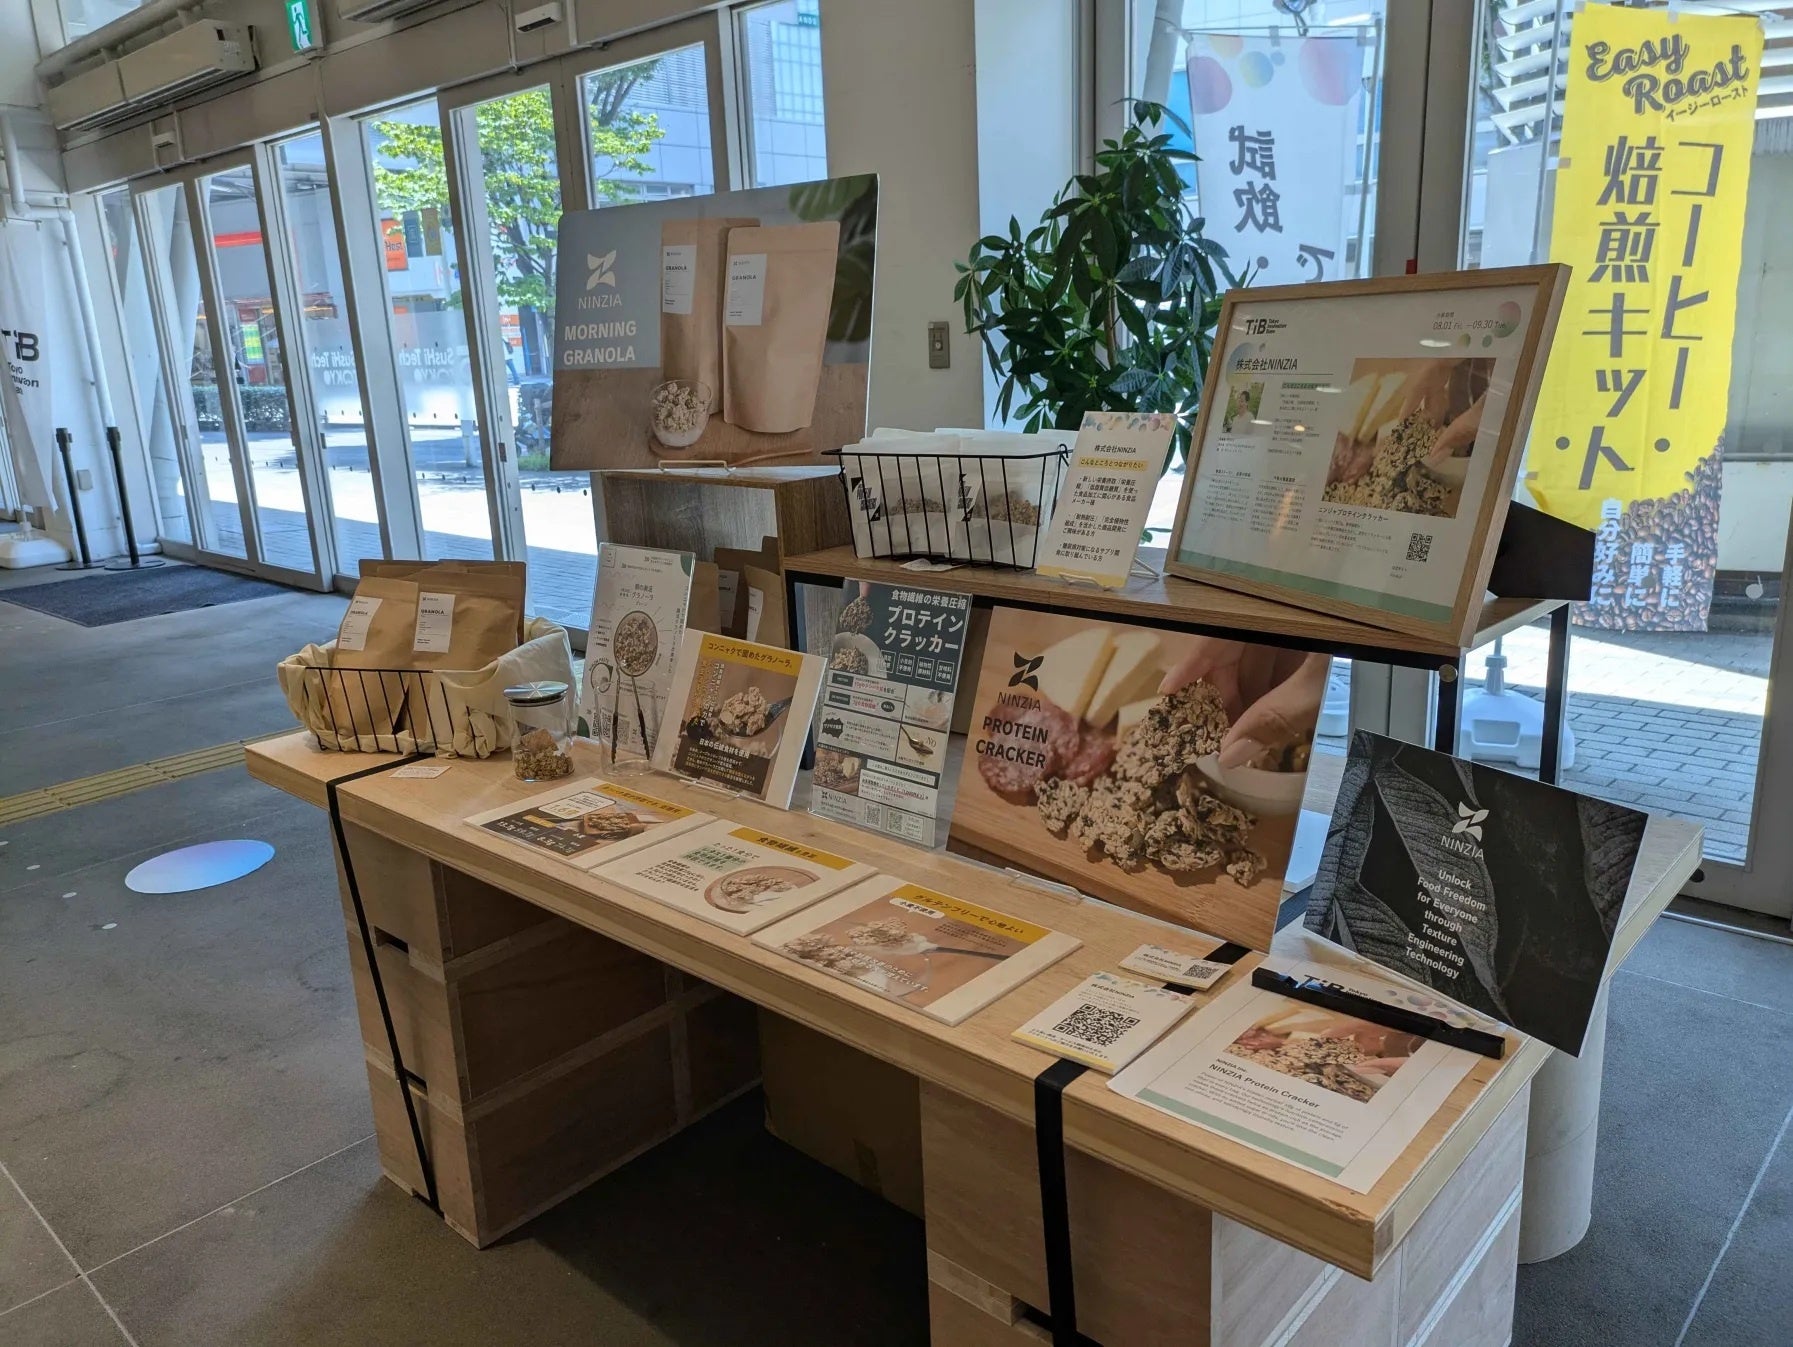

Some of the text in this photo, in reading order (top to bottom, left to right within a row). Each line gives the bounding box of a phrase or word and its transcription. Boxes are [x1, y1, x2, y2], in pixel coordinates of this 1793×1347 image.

[1585, 33, 1689, 82] Easy
[1622, 44, 1750, 116] Roast
[1665, 86, 1749, 122] イージーロースト
[1660, 140, 1725, 410] コーヒー
[577, 294, 622, 310] NINZIA
[1577, 136, 1666, 491] 焙煎キット
[563, 320, 638, 341] MORNING
[1245, 318, 1268, 336] TiB
[562, 345, 636, 366] GRANOLA
[1236, 358, 1298, 371] 株式会社NINZIA
[1080, 458, 1144, 469] こんなところとつながりたい
[1094, 444, 1137, 454] 株式会社NINZIA
[1318, 507, 1409, 522] ニンジャプロテインクラッカー
[1590, 497, 1623, 607] 自分好みに
[1625, 542, 1654, 608] 簡単に
[1659, 543, 1685, 608] 手軽に
[891, 588, 968, 610] 食物繊維の栄養圧縮
[887, 605, 964, 634] プロテイン
[883, 626, 960, 653] クラッカー
[997, 691, 1043, 713] NINZIA
[982, 715, 1049, 745] PROTEIN
[975, 739, 1047, 769] CRACKER
[1440, 835, 1485, 861] NINZIA
[1416, 876, 1487, 912] Food Freedom
[1437, 868, 1473, 891] Unlock
[914, 894, 1025, 936] グルテンフリーで心地よい
[1416, 890, 1479, 926] for Everyone
[1424, 909, 1463, 935] through
[1407, 932, 1465, 967] Engineering
[1421, 924, 1458, 947] Texture
[1404, 947, 1460, 980] Technology
[1208, 1064, 1321, 1109] NINZIA Protein Cracker
